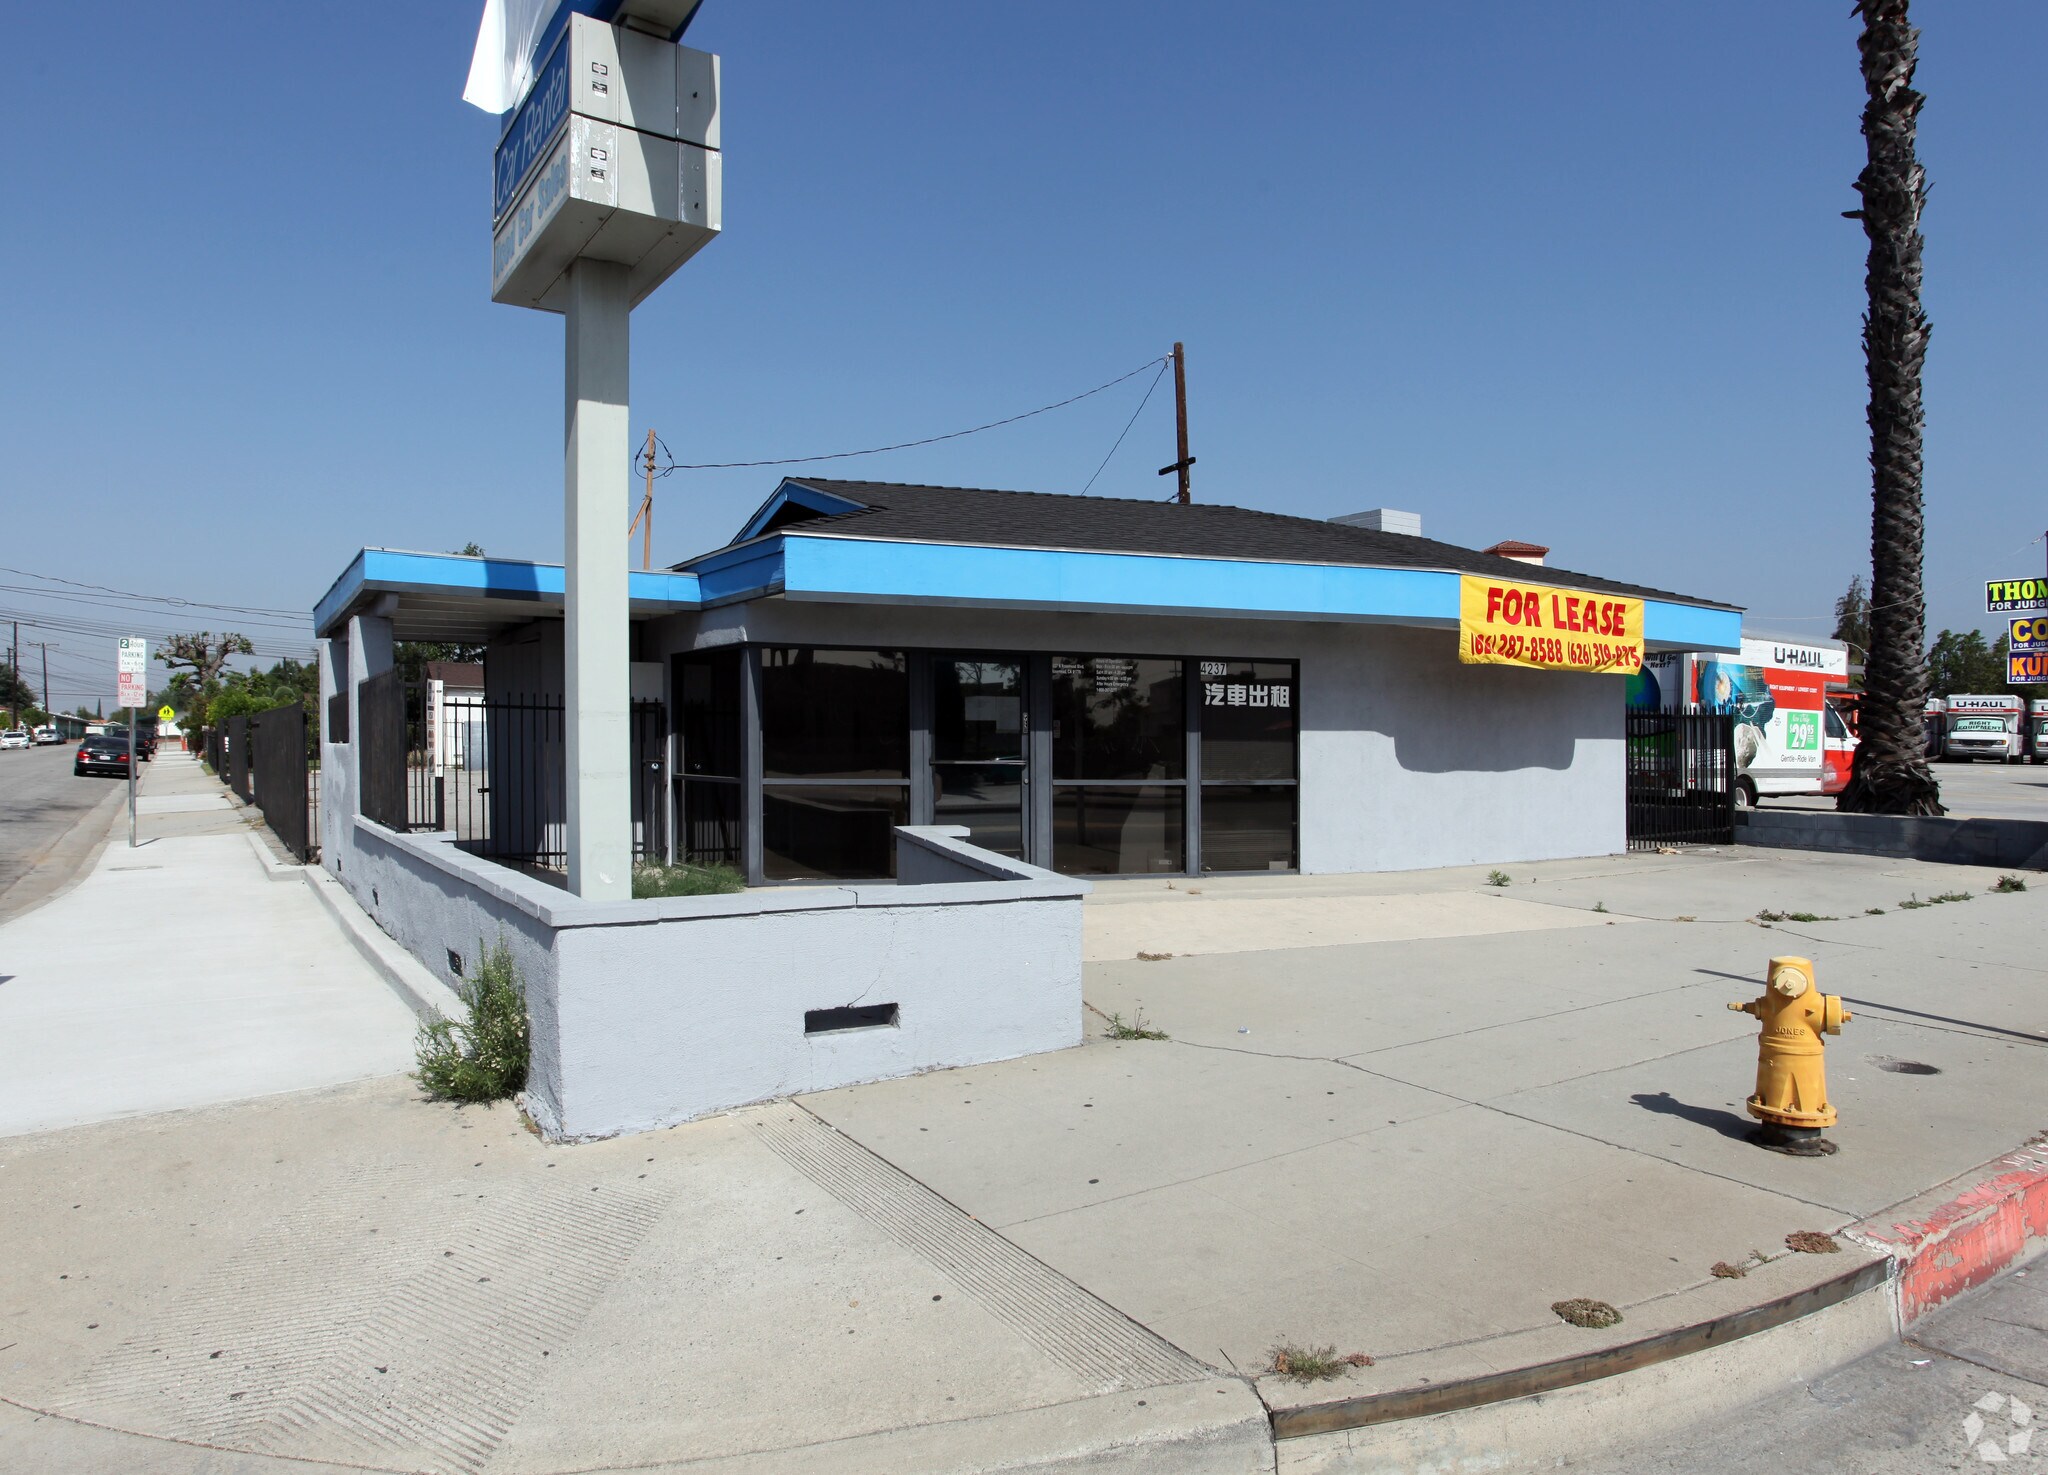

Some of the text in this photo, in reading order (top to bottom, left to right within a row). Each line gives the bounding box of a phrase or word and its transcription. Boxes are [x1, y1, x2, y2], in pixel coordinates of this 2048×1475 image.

[497, 41, 569, 205] Car Rental
[518, 199, 535, 247] Car
[537, 154, 567, 219] Sales
[1989, 599, 2047, 611] FOR JUDG
[1486, 586, 1626, 637] FOR LEASE
[121, 639, 128, 648] 2
[121, 651, 144, 659] PARKING
[1660, 653, 1666, 662] U
[1774, 646, 1824, 669] U-HAUL
[1200, 663, 1226, 675] 4237
[120, 673, 131, 683] NO
[1205, 683, 1290, 707] 汽車出租
[1808, 755, 1816, 763] Van
[1775, 1026, 1806, 1036] JONES
